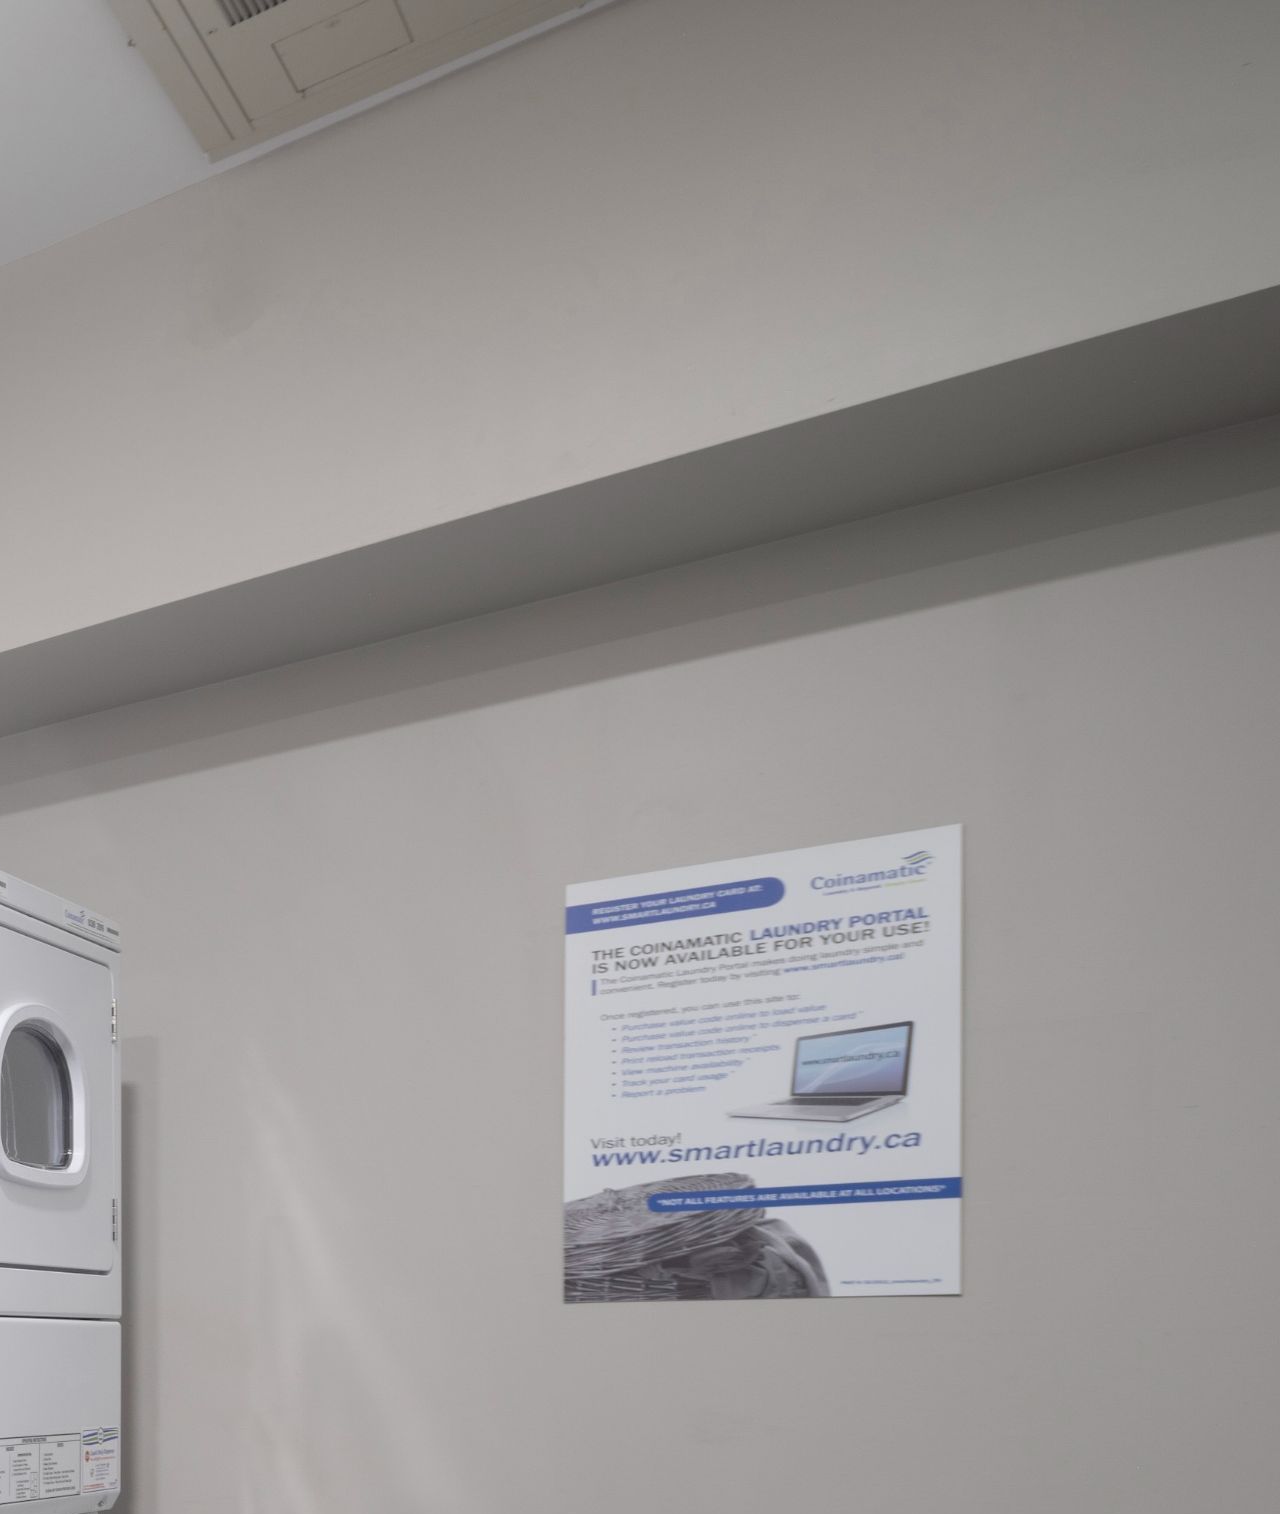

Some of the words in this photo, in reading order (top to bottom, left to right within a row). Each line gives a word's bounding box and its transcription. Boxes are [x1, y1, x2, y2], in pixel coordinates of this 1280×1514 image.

[810, 860, 926, 890] Coinamatic
[591, 947, 624, 961] THE
[630, 931, 742, 956] COINAMATIC
[750, 917, 842, 940] LAUNDRY
[848, 906, 927, 927] PORTAL
[591, 962, 608, 974] IS
[614, 956, 658, 971] NOW
[664, 942, 766, 965] AVAILABLE
[773, 936, 812, 951] FOR
[819, 928, 875, 945] YOUR
[882, 921, 930, 937] USE!
[590, 1136, 624, 1150] Visit
[630, 1132, 680, 1149] today!
[591, 1131, 922, 1168] www.smartlaundry.ca
[684, 1197, 702, 1205] ALL
[705, 1195, 753, 1204] FEATURES
[755, 1193, 776, 1201] ARE
[779, 1190, 836, 1200] AVAILABLE
[838, 1189, 851, 1197] AT
[854, 1188, 874, 1196] ALL
